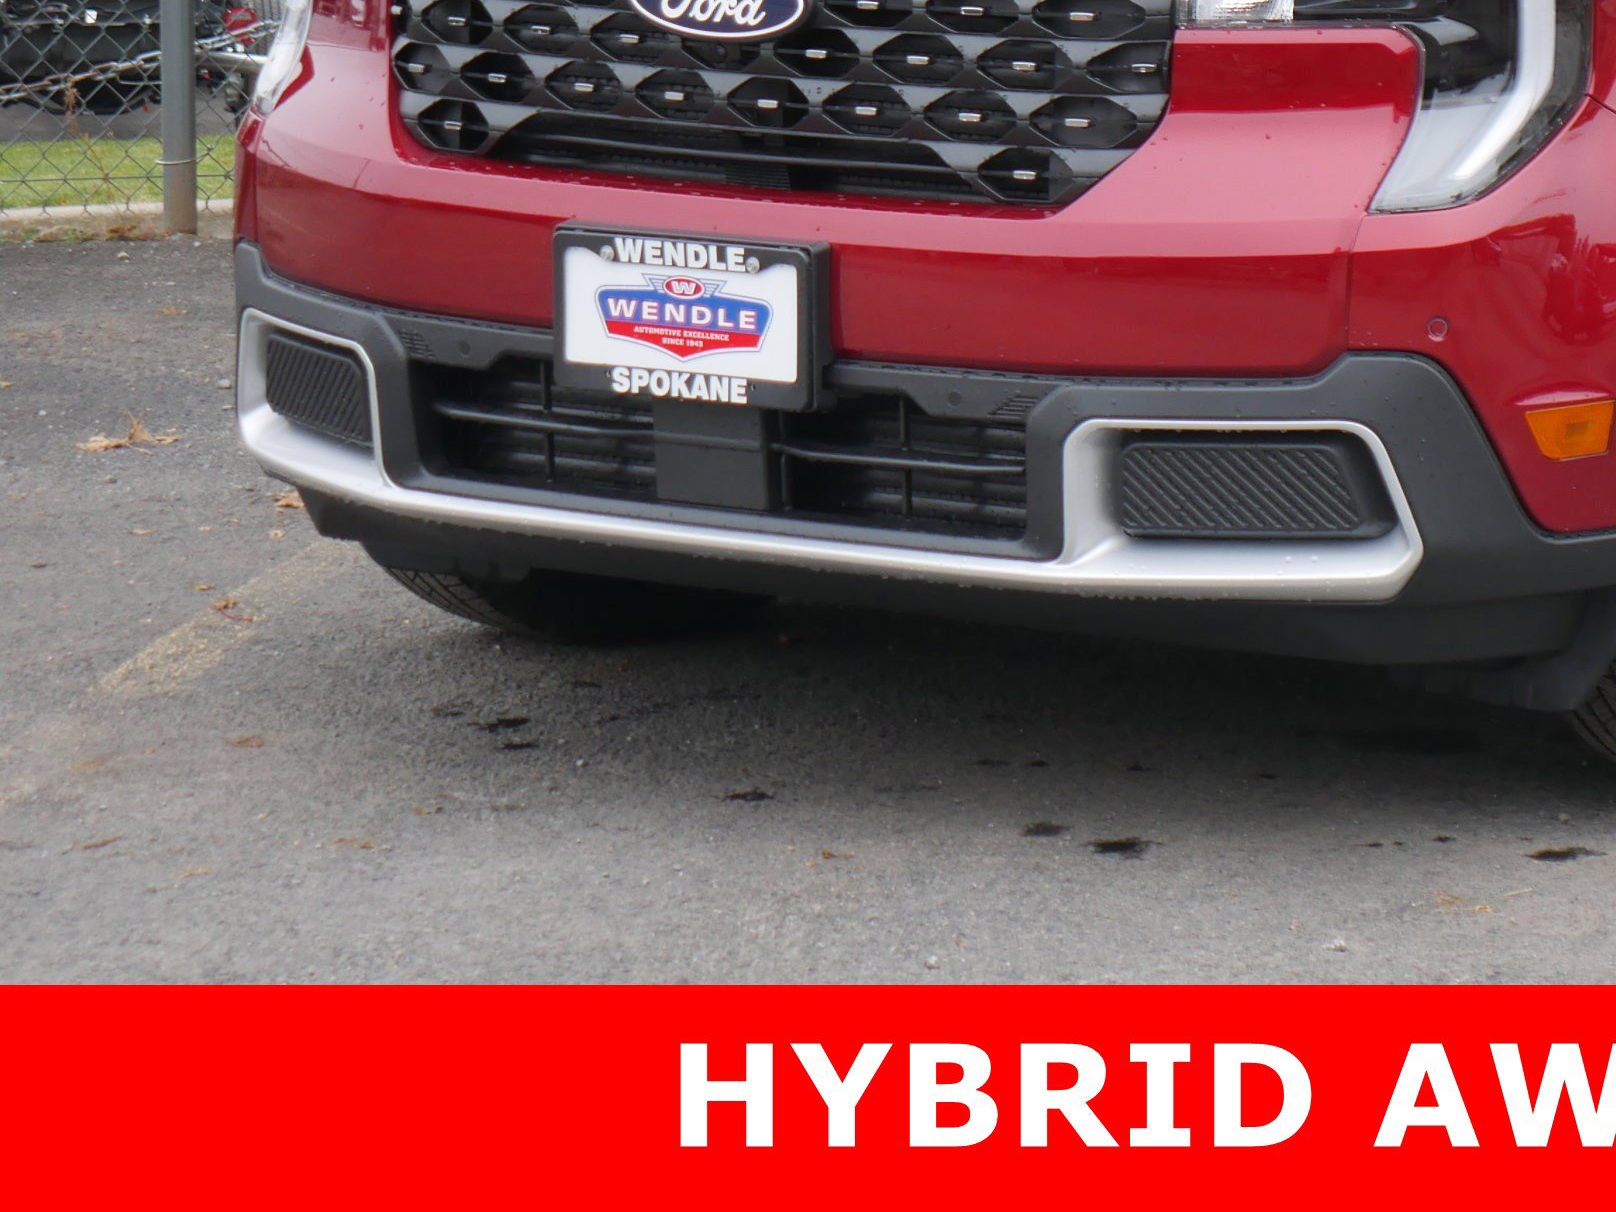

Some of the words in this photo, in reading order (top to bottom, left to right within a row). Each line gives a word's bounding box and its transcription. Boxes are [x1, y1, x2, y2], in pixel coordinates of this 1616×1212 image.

[614, 237, 746, 272] WENDLE
[670, 280, 697, 295] W
[607, 297, 757, 330] WENDLE
[633, 326, 682, 338] AUTOMOTIVE
[683, 330, 730, 342] EXCELLENCE
[661, 337, 685, 346] SINCE
[686, 339, 704, 347] 1943
[611, 366, 748, 404] SPOKANE
